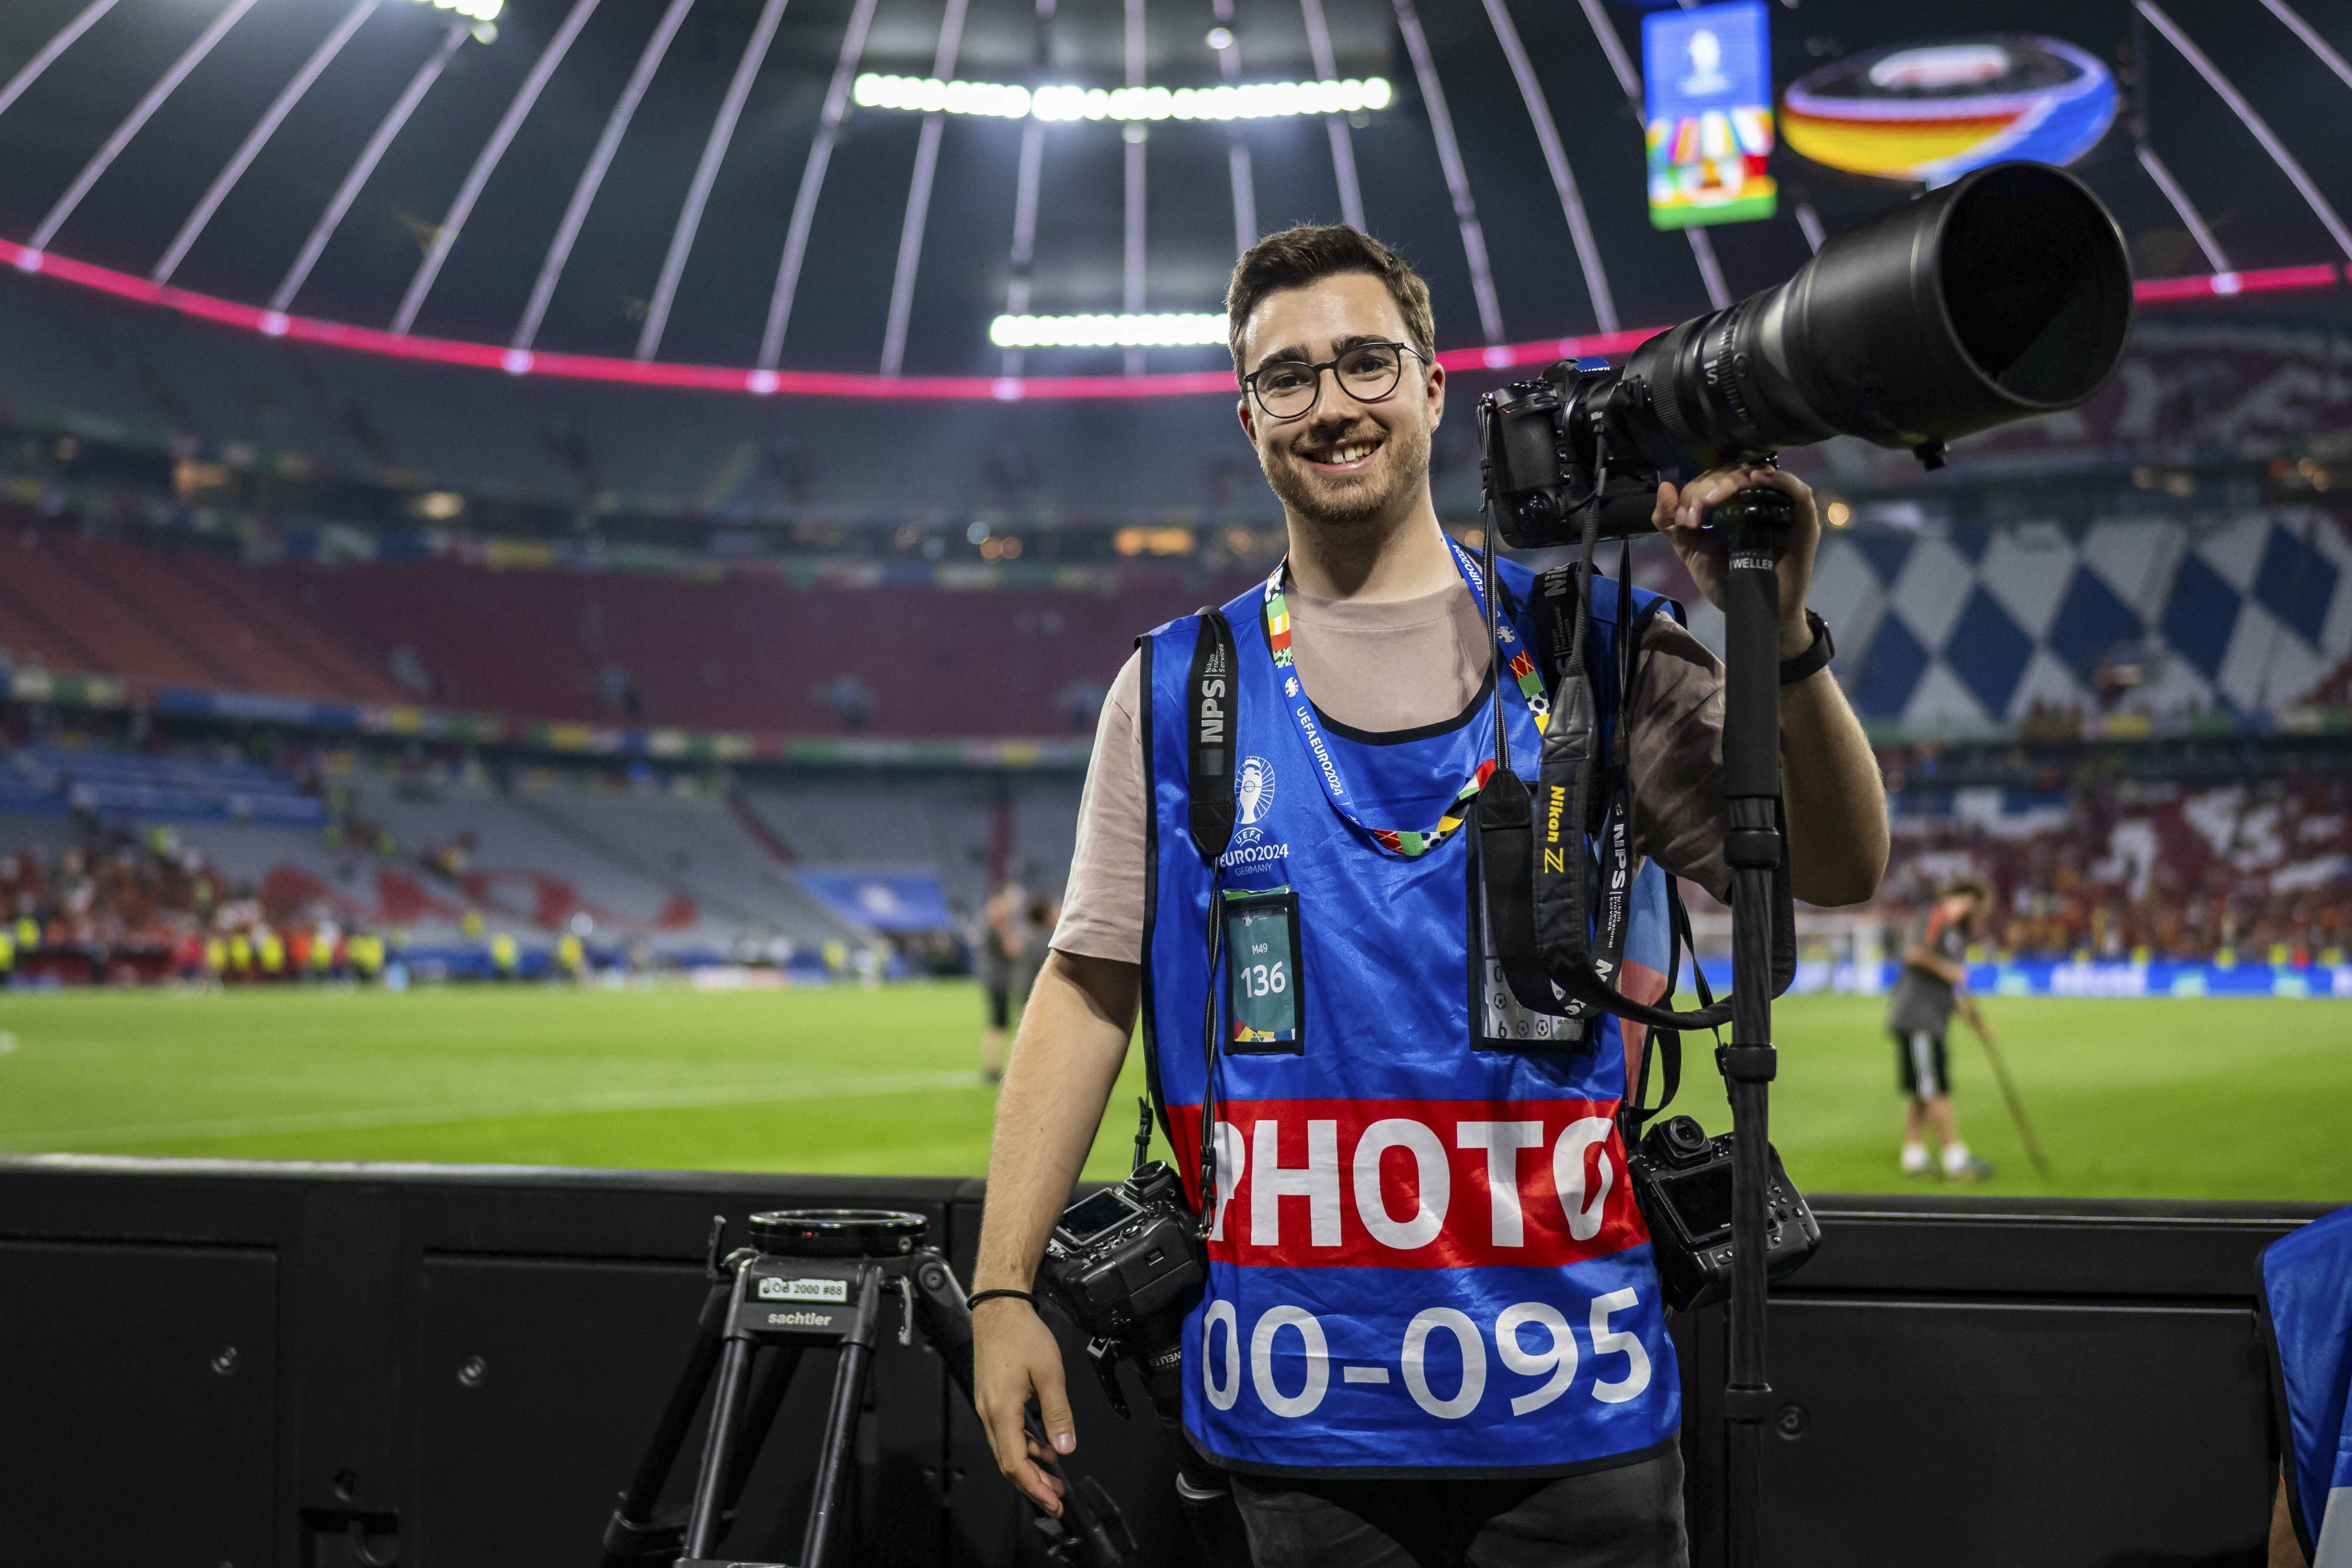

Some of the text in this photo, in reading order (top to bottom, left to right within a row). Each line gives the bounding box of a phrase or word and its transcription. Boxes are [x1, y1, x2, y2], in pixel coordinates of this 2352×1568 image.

[1201, 679, 1225, 743] NPS
[1235, 830, 1261, 844] UEFA
[1544, 785, 1565, 874] Nikon Z
[1220, 843, 1289, 868] EURO2024
[1235, 862, 1272, 876] GERMANY
[1611, 824, 1626, 889] NPS
[1252, 943, 1268, 955] M49
[1241, 961, 1285, 998] 136
[1208, 1116, 1613, 1250] PHOTO
[793, 1283, 820, 1294] 2000
[823, 1285, 843, 1295] #88
[768, 1312, 833, 1326] sachtler
[1202, 1286, 1652, 1419] 00-095
